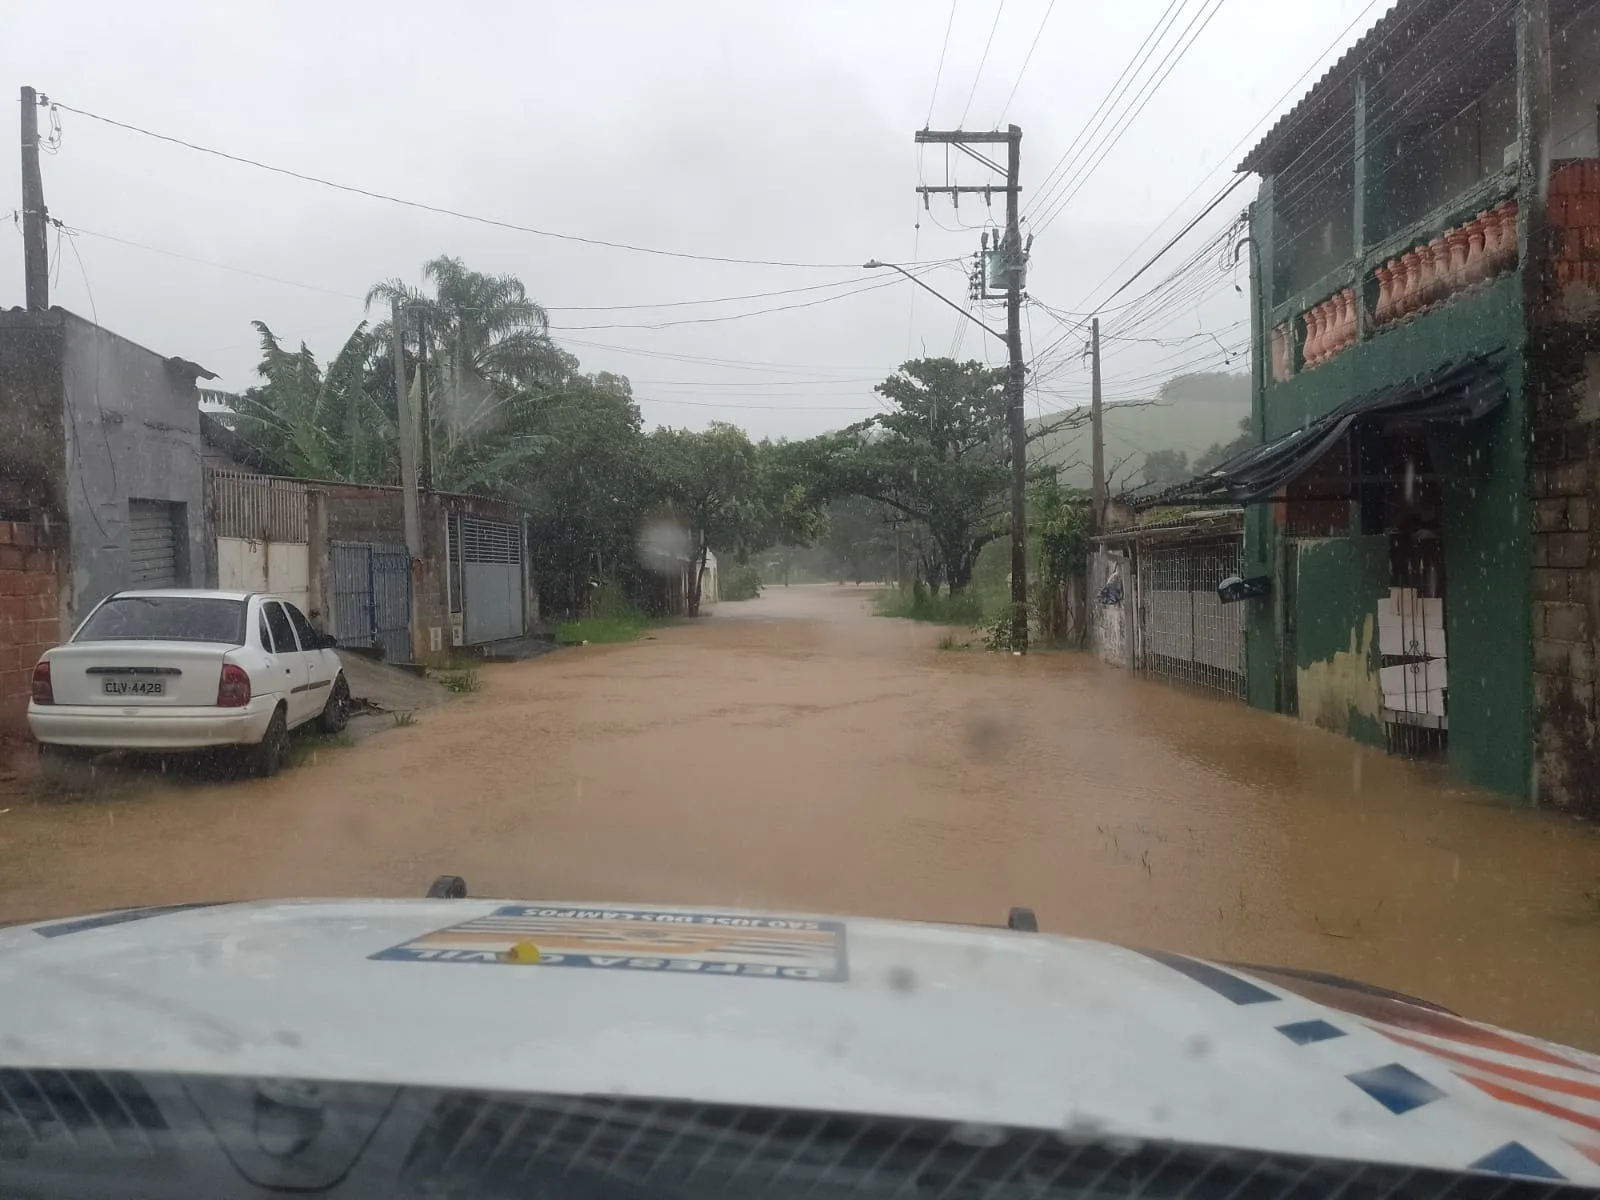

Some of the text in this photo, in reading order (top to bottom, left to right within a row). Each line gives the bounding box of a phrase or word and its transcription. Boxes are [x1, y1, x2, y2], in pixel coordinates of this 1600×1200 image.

[521, 907, 634, 921] CAMPOS
[640, 913, 693, 924] DOS
[416, 949, 820, 978] DEFESA CVIL
